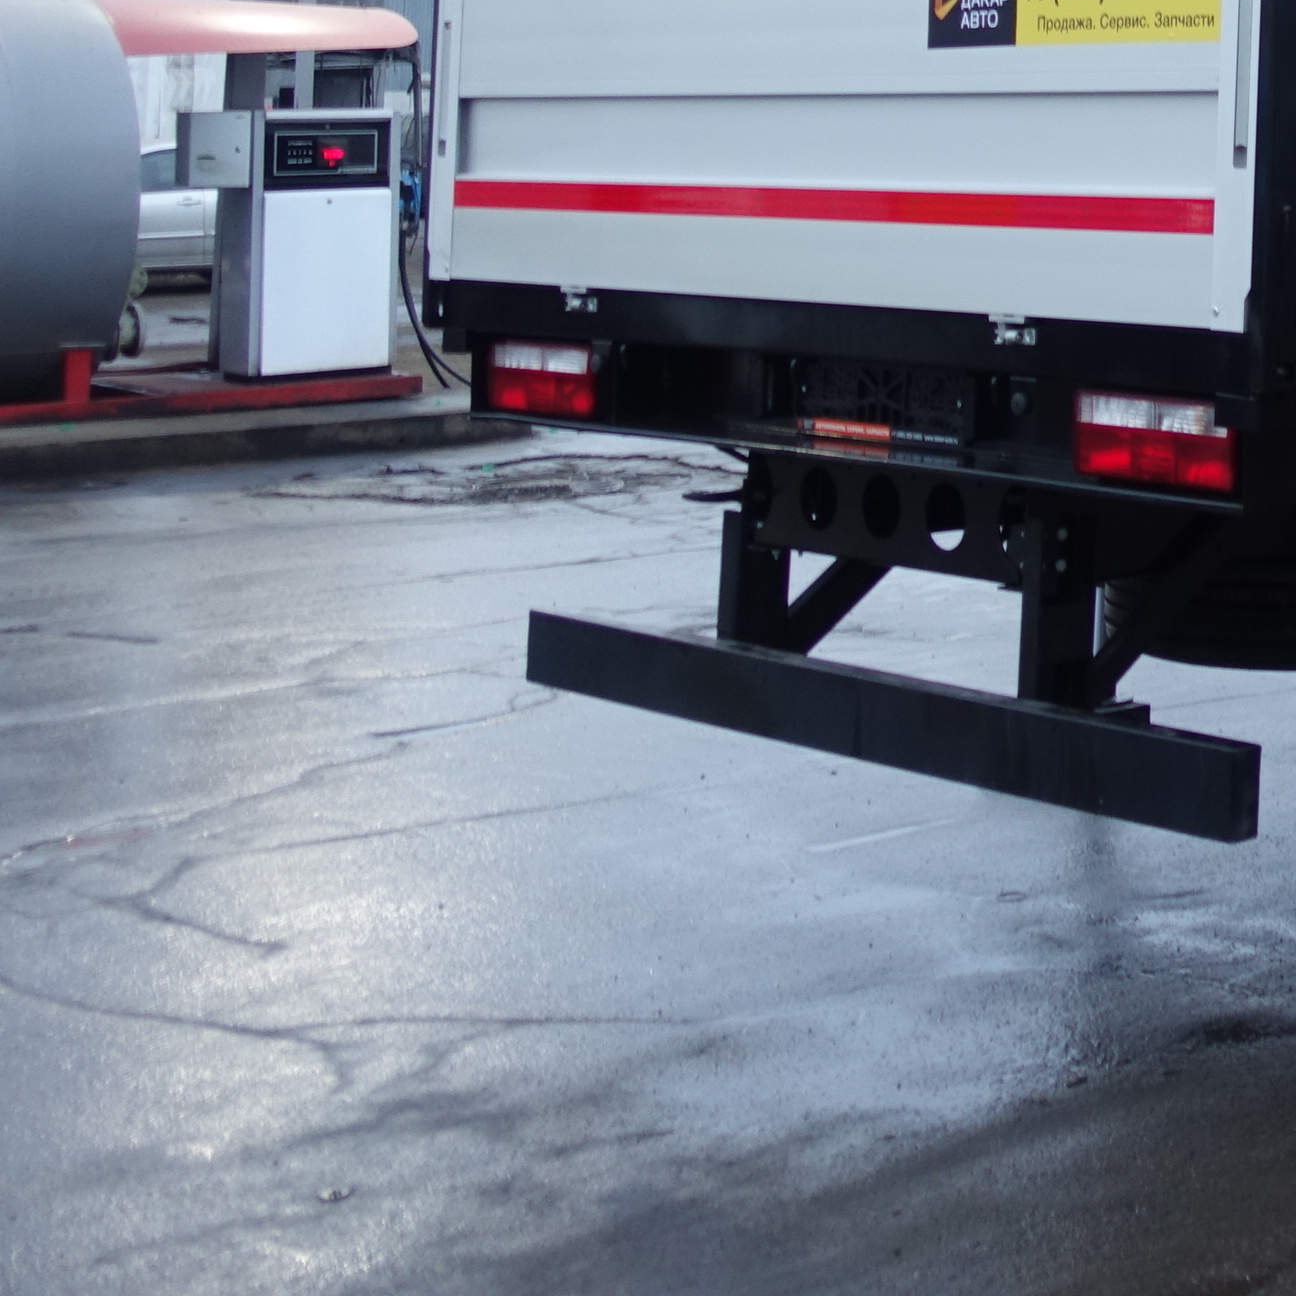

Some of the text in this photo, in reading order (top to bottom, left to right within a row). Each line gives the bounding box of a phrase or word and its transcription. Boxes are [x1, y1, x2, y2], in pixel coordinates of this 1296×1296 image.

[960, 9, 999, 30] АВТО
[1037, 12, 1215, 34] Продажа. Сервис. Запчасти
